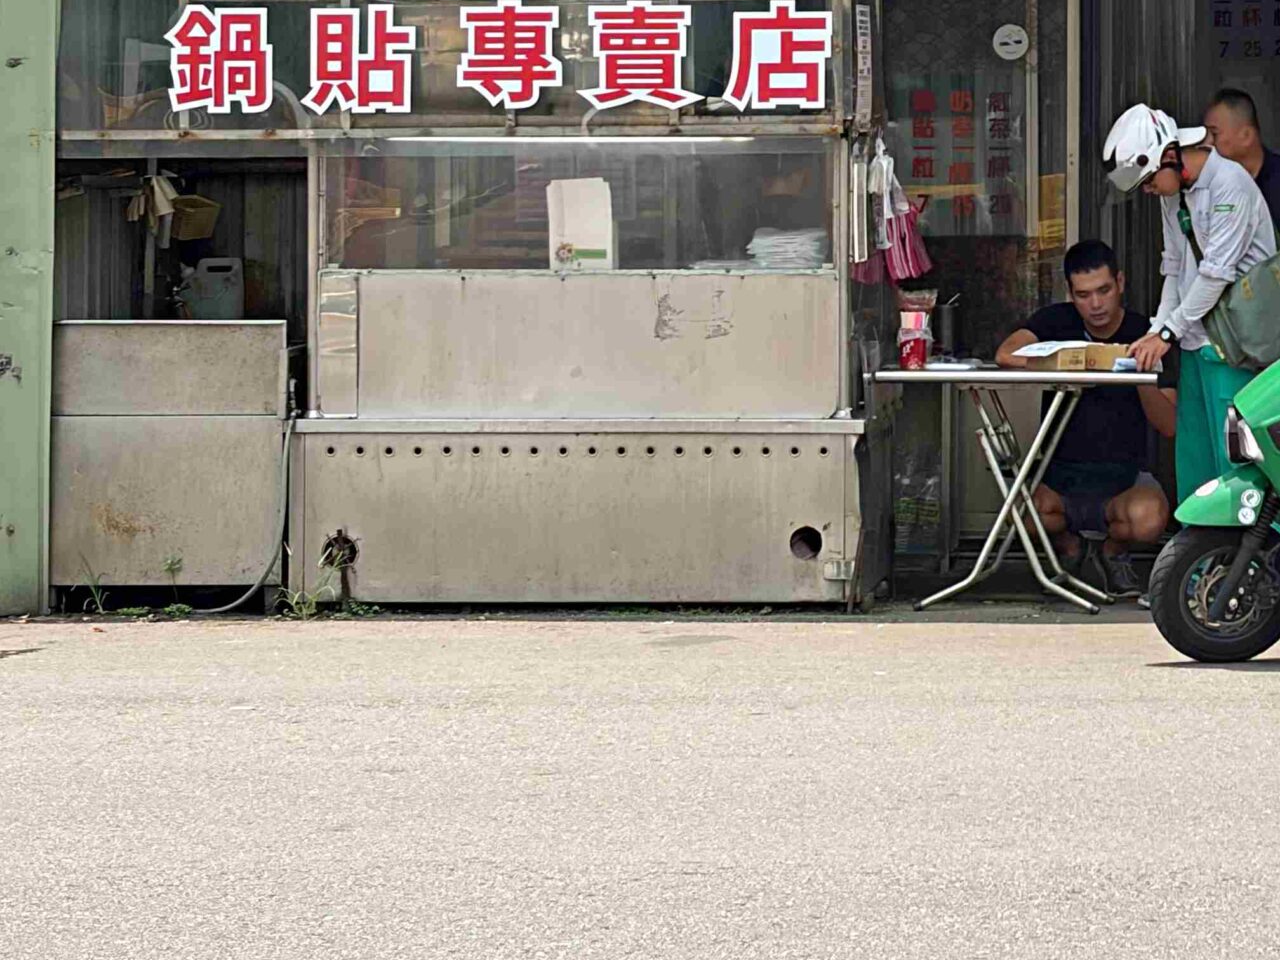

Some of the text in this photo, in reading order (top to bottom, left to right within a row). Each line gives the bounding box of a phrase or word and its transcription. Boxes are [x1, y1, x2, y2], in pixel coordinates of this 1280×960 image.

[168, 1, 832, 113] 鍋貼專賣店
[1218, 40, 1231, 58] 7
[1243, 40, 1262, 58] 25
